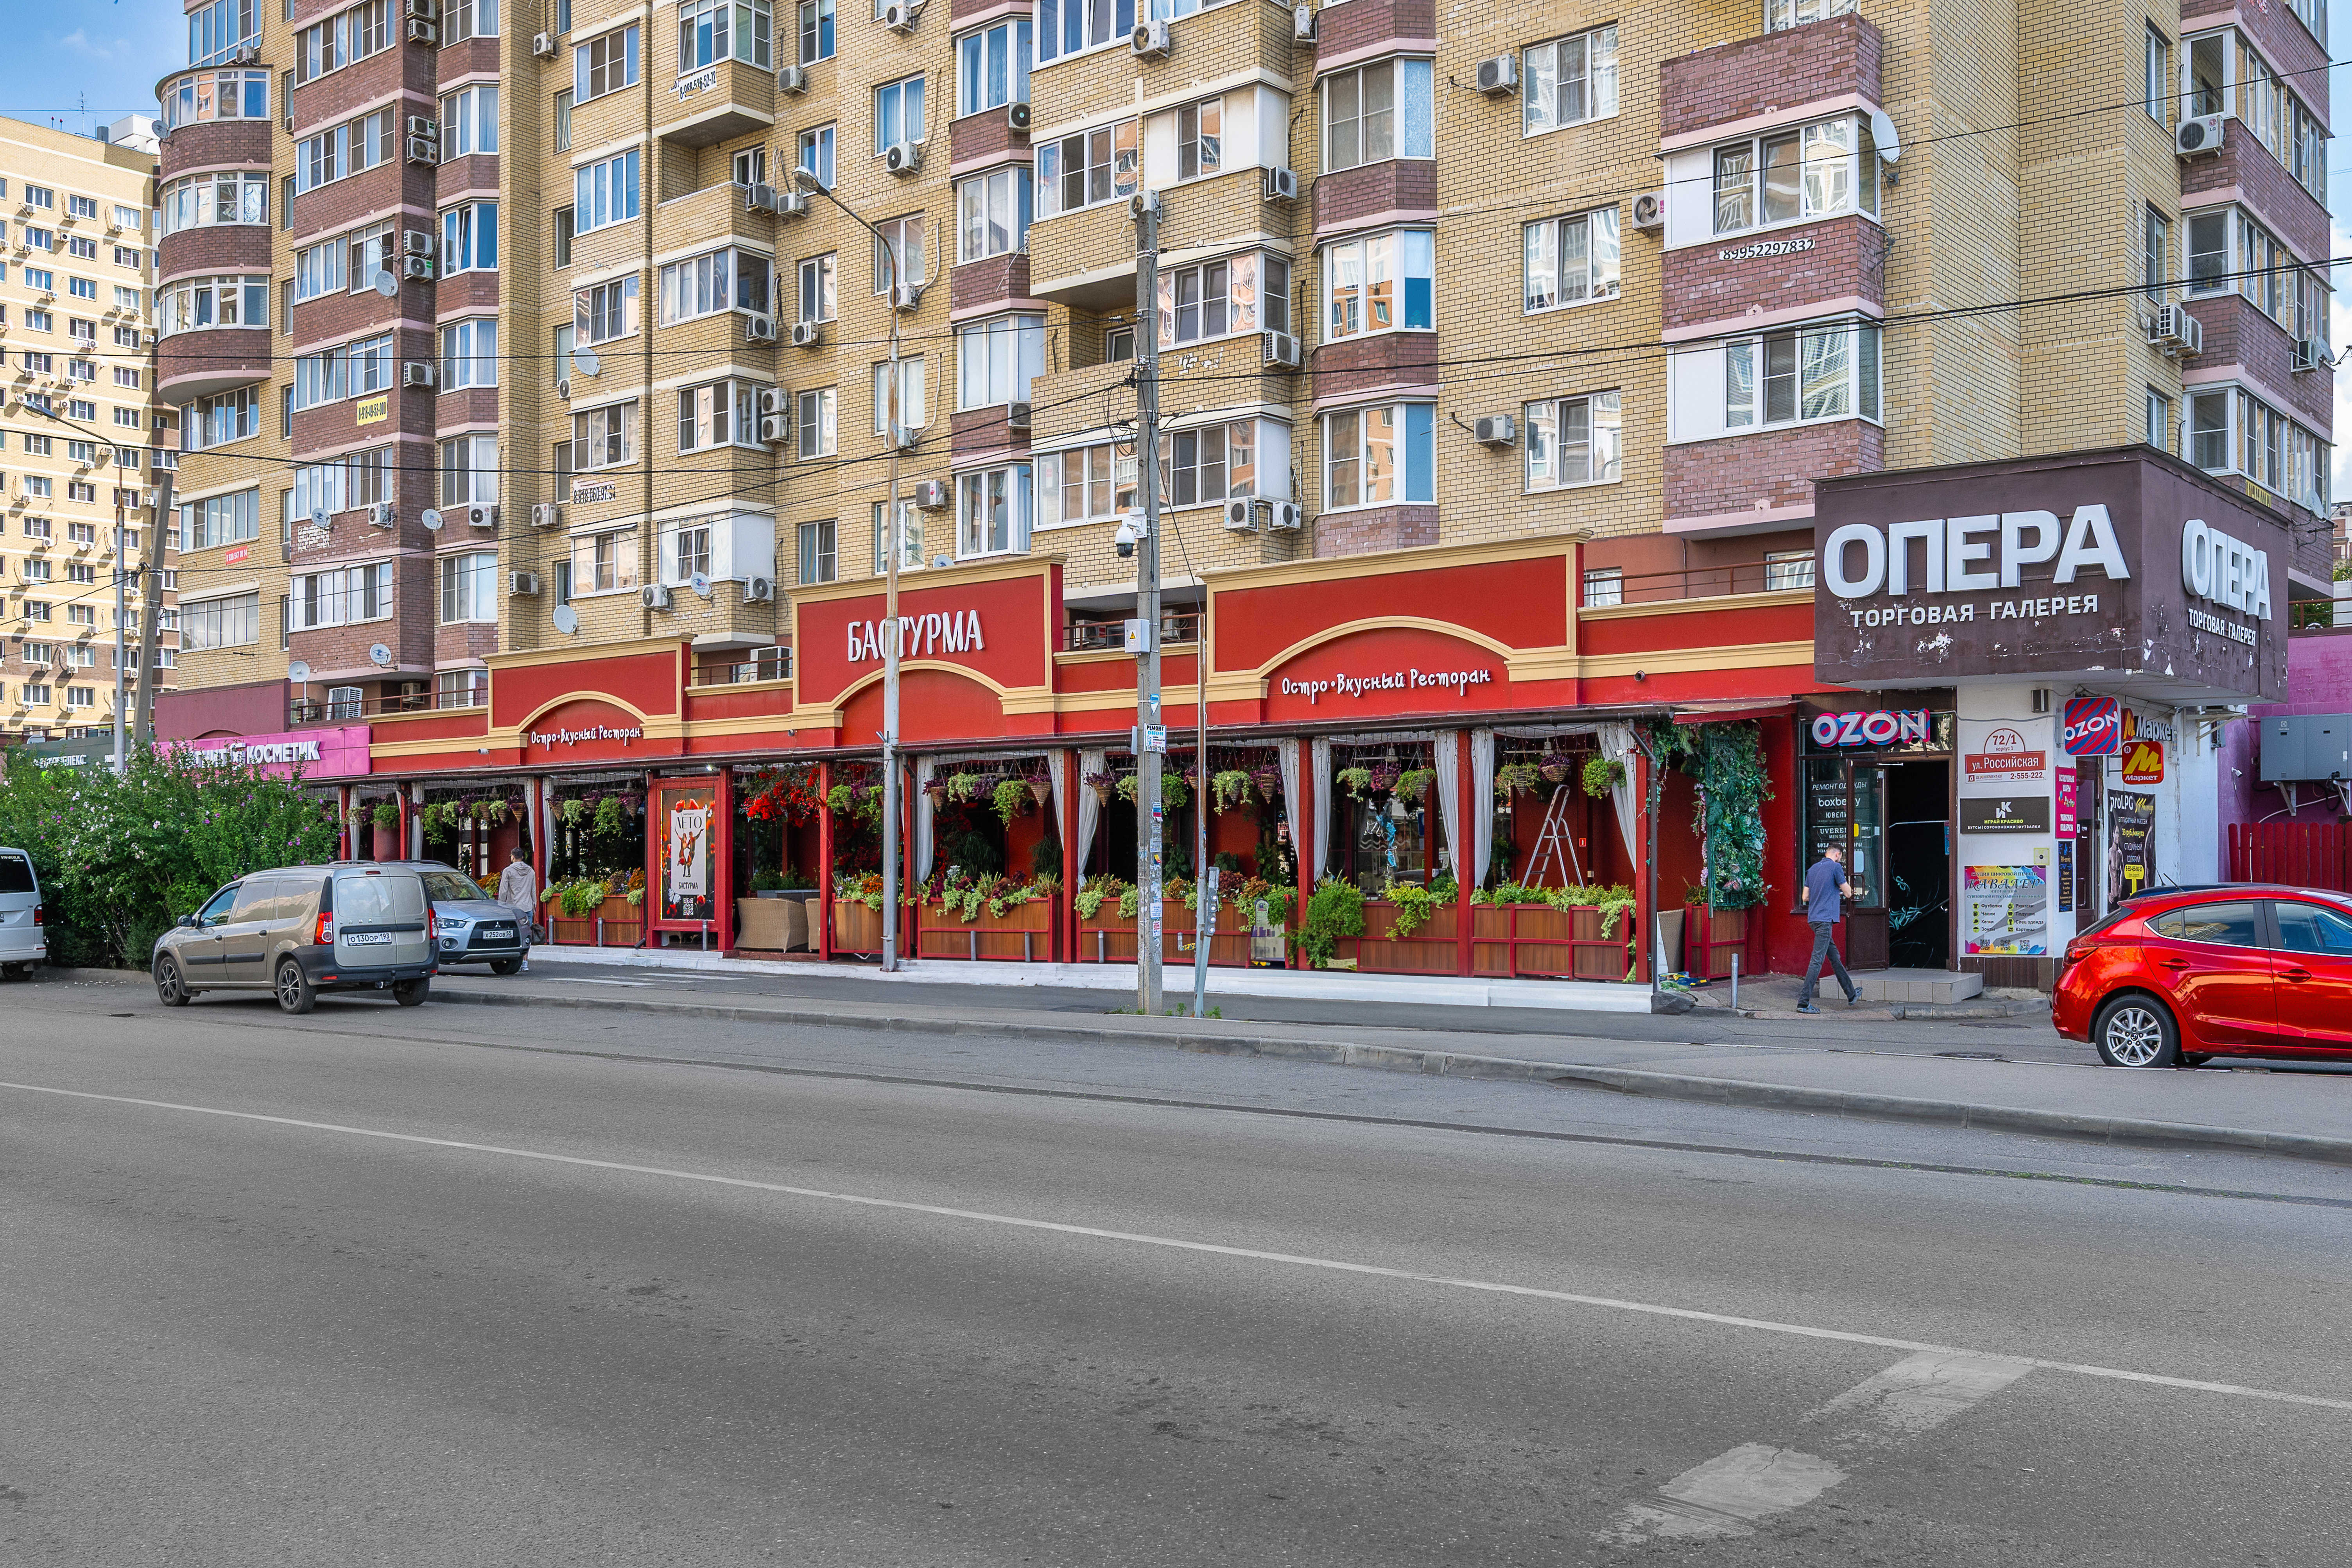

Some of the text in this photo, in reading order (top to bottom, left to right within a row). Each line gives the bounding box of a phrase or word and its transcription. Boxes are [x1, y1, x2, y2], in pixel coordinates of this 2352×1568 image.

[1723, 240, 1814, 260] 89952297832
[1824, 504, 2130, 599] ОПЕРА
[2183, 519, 2272, 621] ОПЕРА
[1851, 594, 2098, 628] ТОРГОВАЯ ГАЛЕРЕЯ
[2189, 608, 2256, 647] ТОРГОВАЯ ГАЛЕРЕЯ
[1410, 668, 1491, 696] Ресторан
[599, 725, 641, 746] Ресторан
[1812, 710, 1929, 745] OZON
[2065, 711, 2118, 740] OZON
[1993, 733, 2016, 746] 72/1
[246, 741, 321, 764] КОСМЕТИК
[1972, 756, 2038, 771] ул. Российская
[1818, 797, 1861, 806] boxbey
[2110, 795, 2133, 812] proLPG
[677, 816, 702, 829] ЛЕТО
[1967, 879, 2040, 891] КАВАЛЕР
